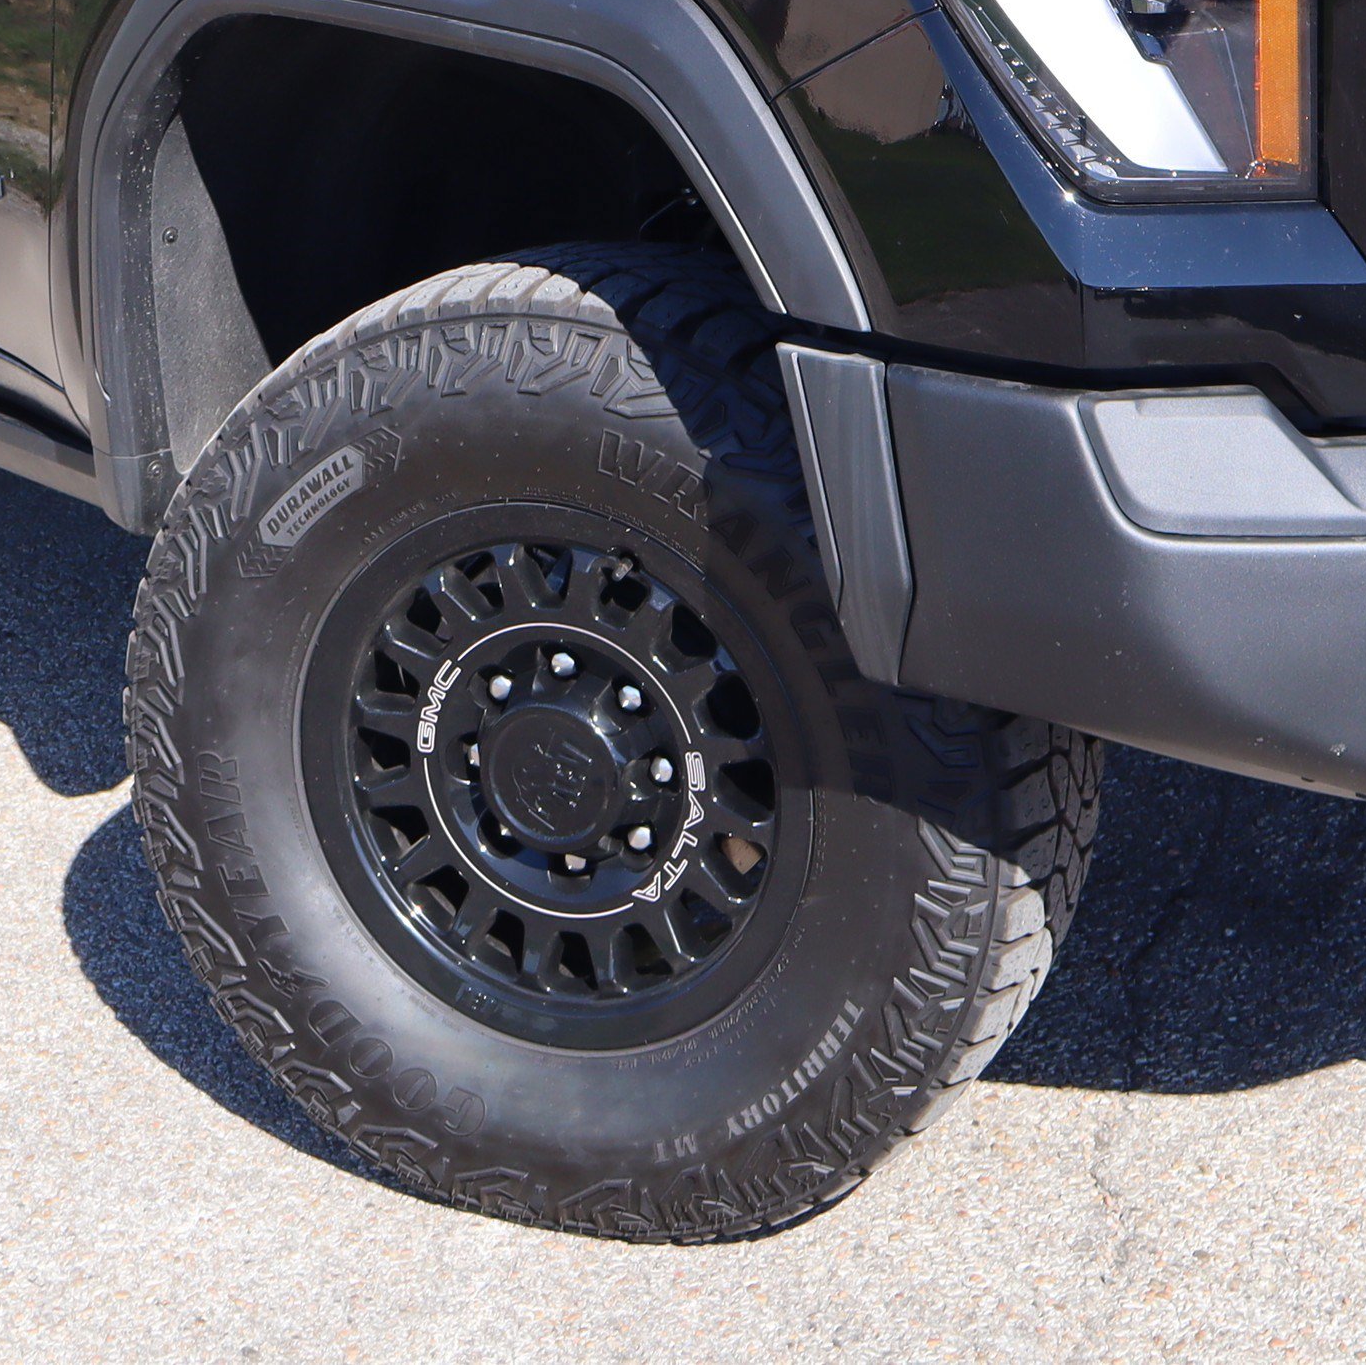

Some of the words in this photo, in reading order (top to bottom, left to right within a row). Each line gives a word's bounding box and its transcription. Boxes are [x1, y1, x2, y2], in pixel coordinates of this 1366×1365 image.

[266, 454, 354, 536] DURAWALL
[287, 477, 351, 537] TECHNOLOGY
[417, 659, 461, 753] GMC
[632, 752, 706, 902] SALTA
[196, 751, 487, 1137] GOODYEAR
[724, 998, 866, 1140] TERRITORY
[653, 1131, 699, 1164] MT
